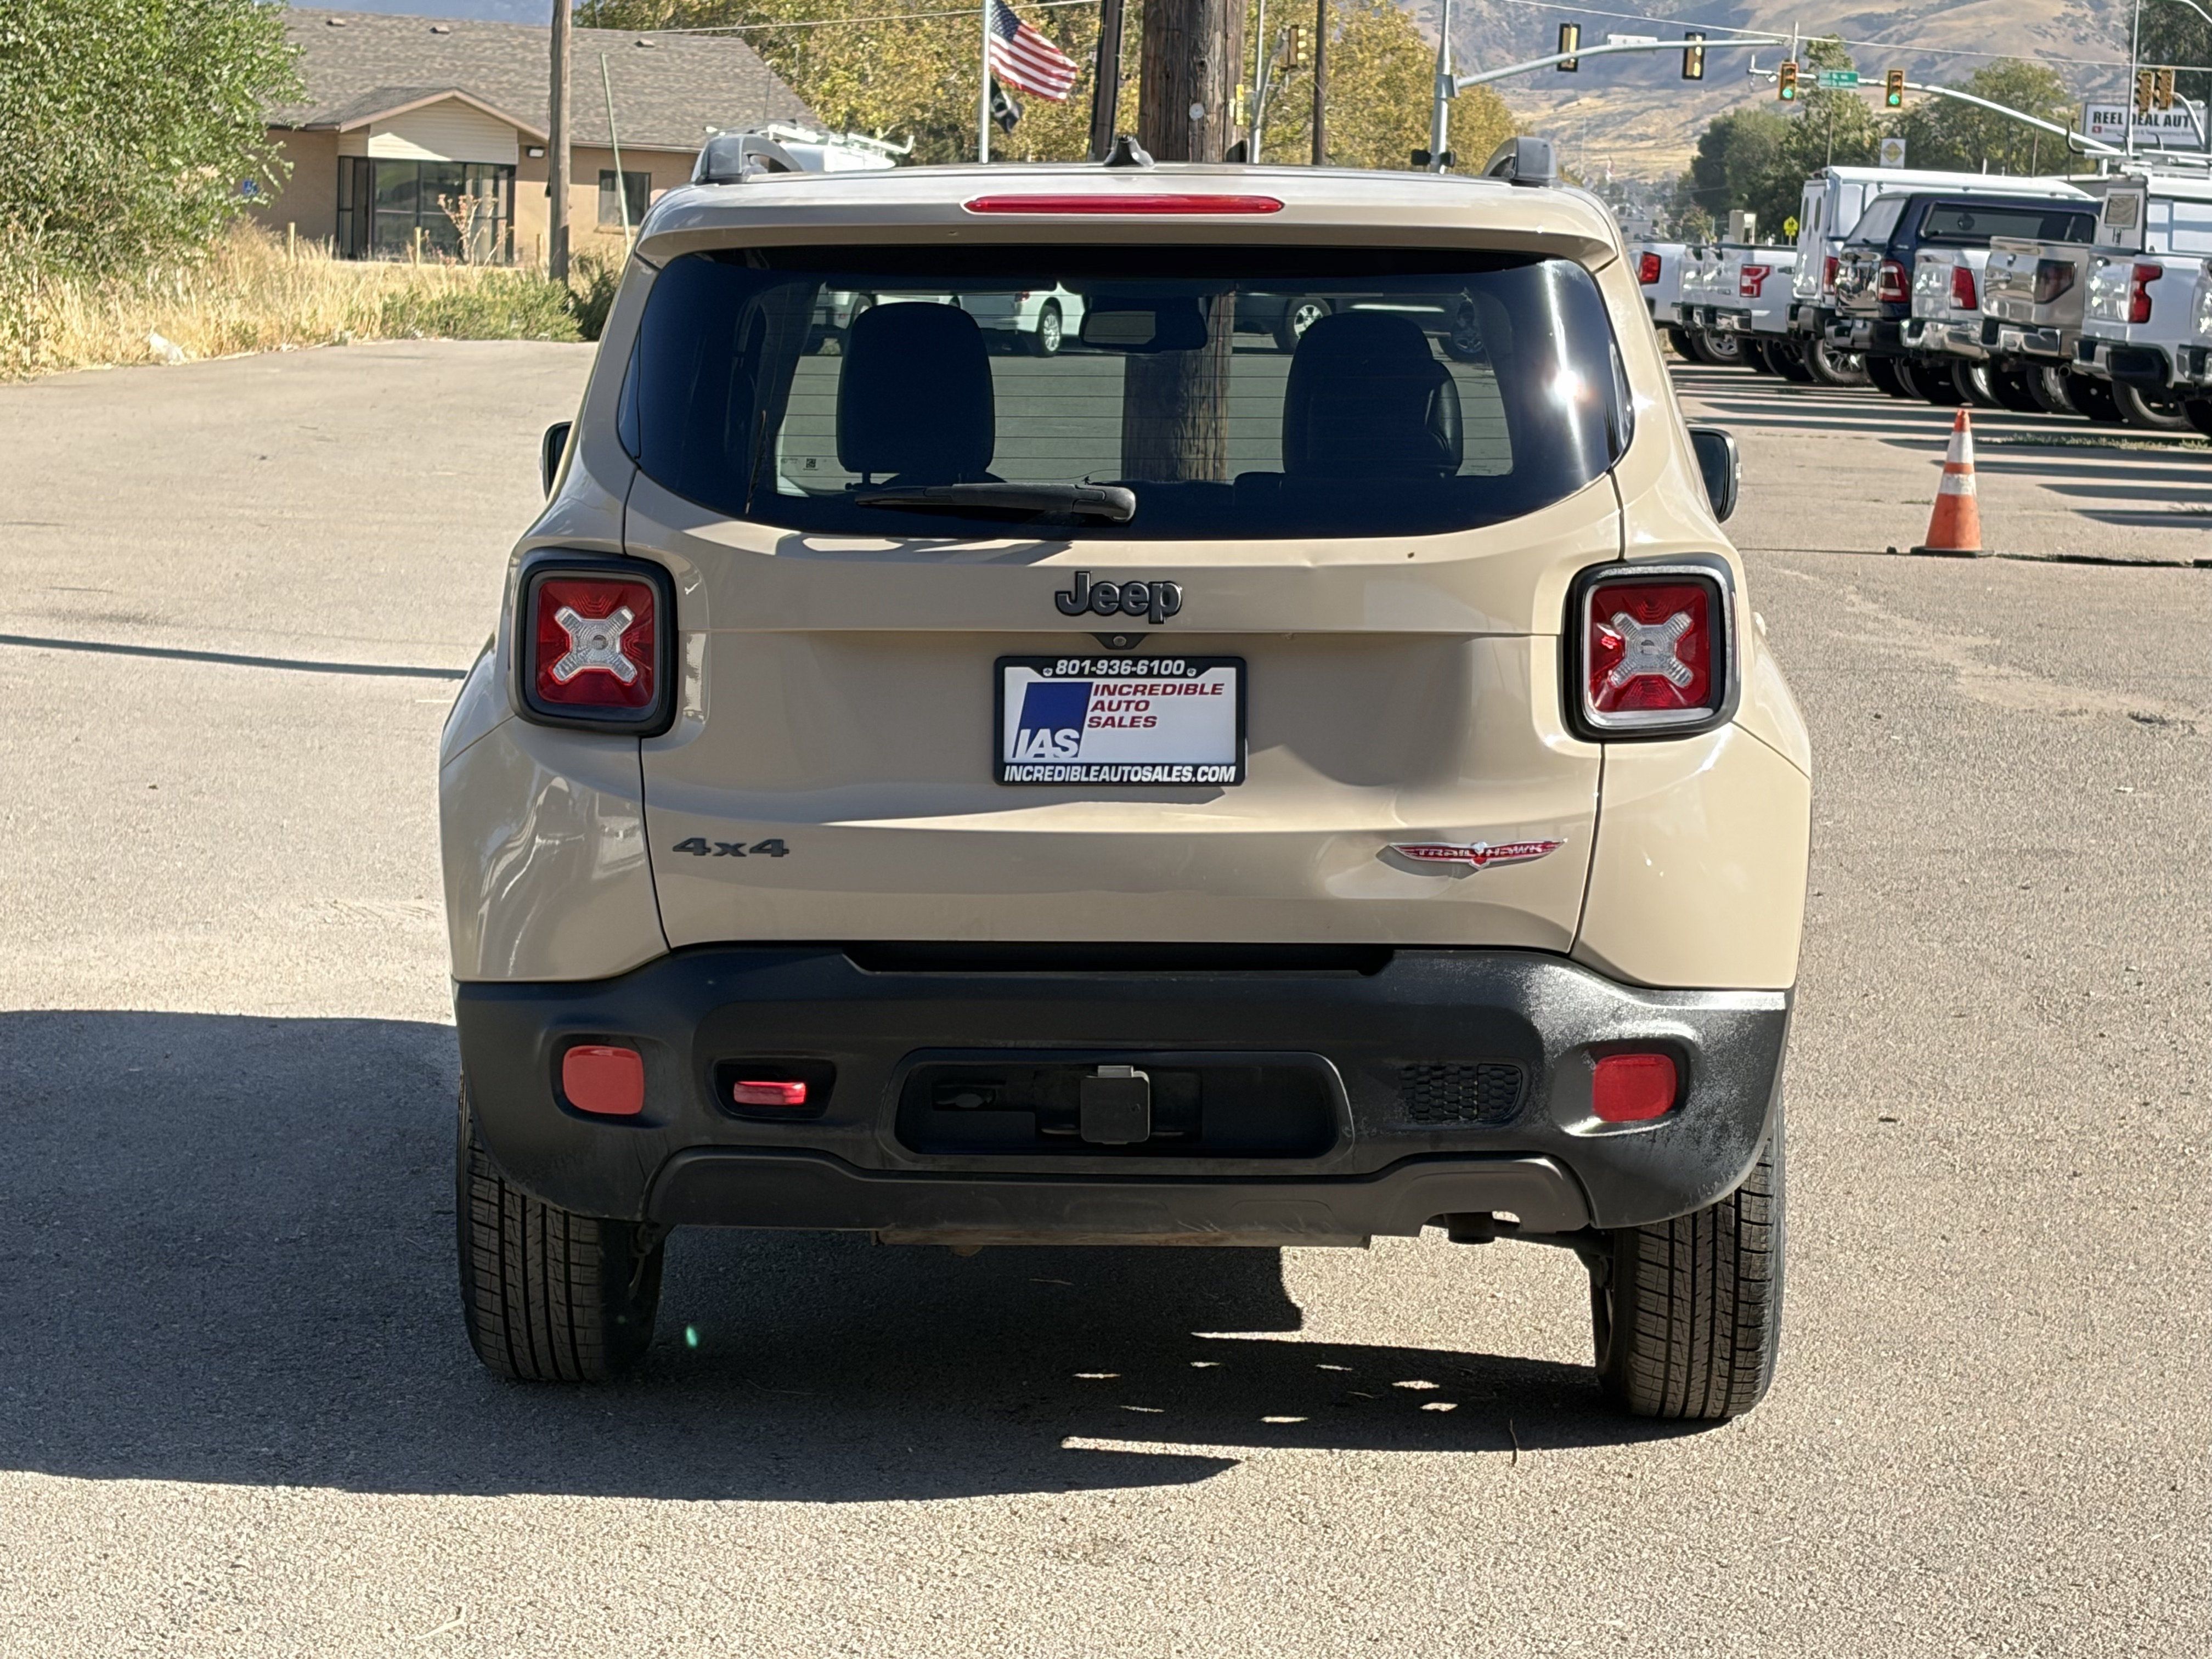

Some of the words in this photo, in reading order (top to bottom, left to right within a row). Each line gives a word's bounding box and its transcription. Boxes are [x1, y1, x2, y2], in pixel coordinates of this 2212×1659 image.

[2093, 111, 2123, 125] REEL
[2163, 114, 2196, 128] AUT
[1054, 571, 1183, 624] Jeep
[1056, 659, 1185, 675] 801-936-6100
[1093, 682, 1224, 696] INCREDIBLE
[1090, 699, 1150, 712] AUTO
[1087, 715, 1158, 729] SALES
[1016, 728, 1080, 758] IAS
[1003, 765, 1236, 782] INCREDIBLEAUTOSALES.COM
